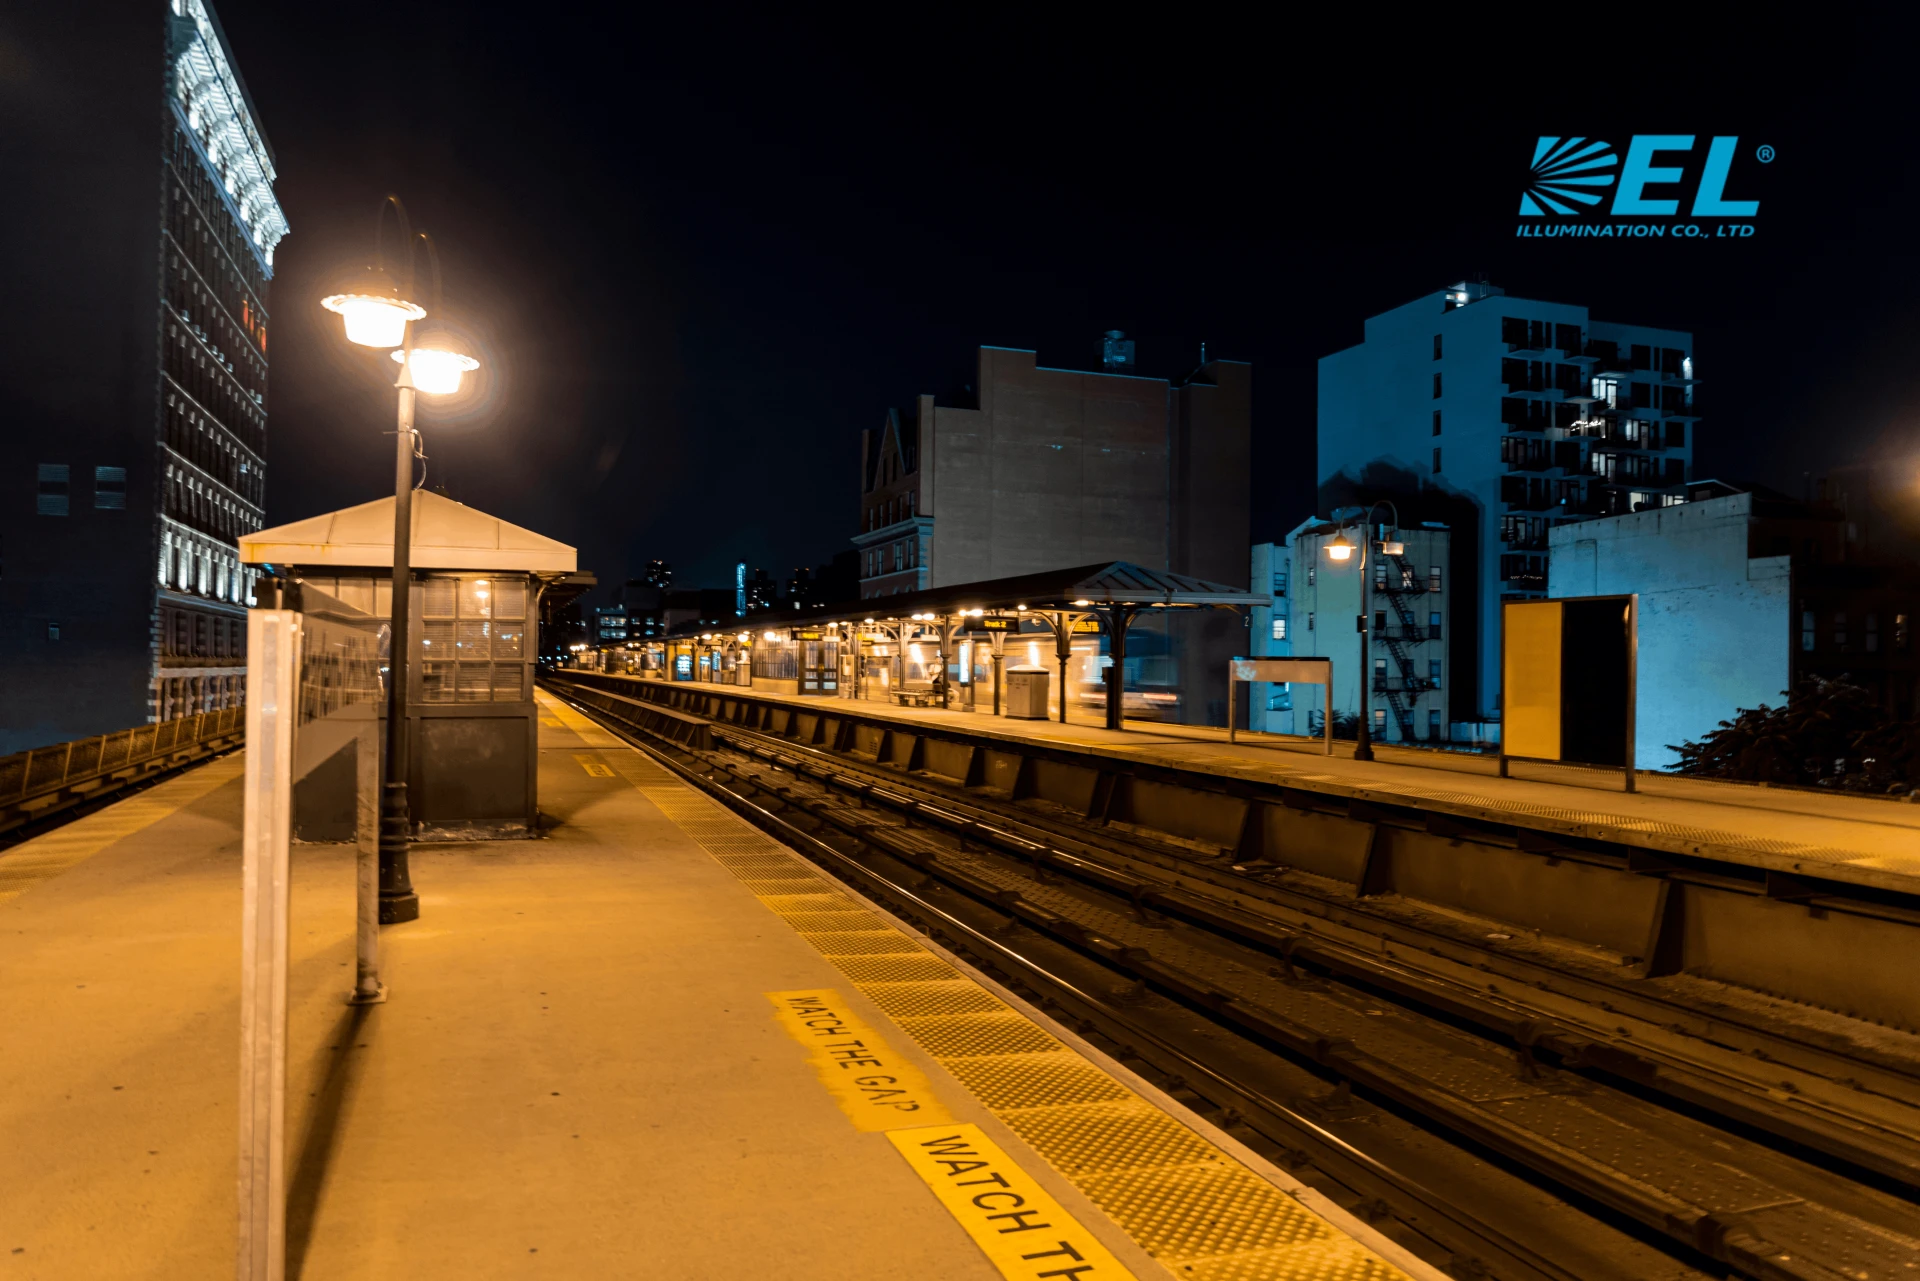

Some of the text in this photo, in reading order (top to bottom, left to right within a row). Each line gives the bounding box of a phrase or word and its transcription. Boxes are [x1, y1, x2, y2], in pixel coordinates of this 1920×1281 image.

[786, 996, 920, 1112] WATCH THE GAP
[919, 1134, 1052, 1234] WATCH
